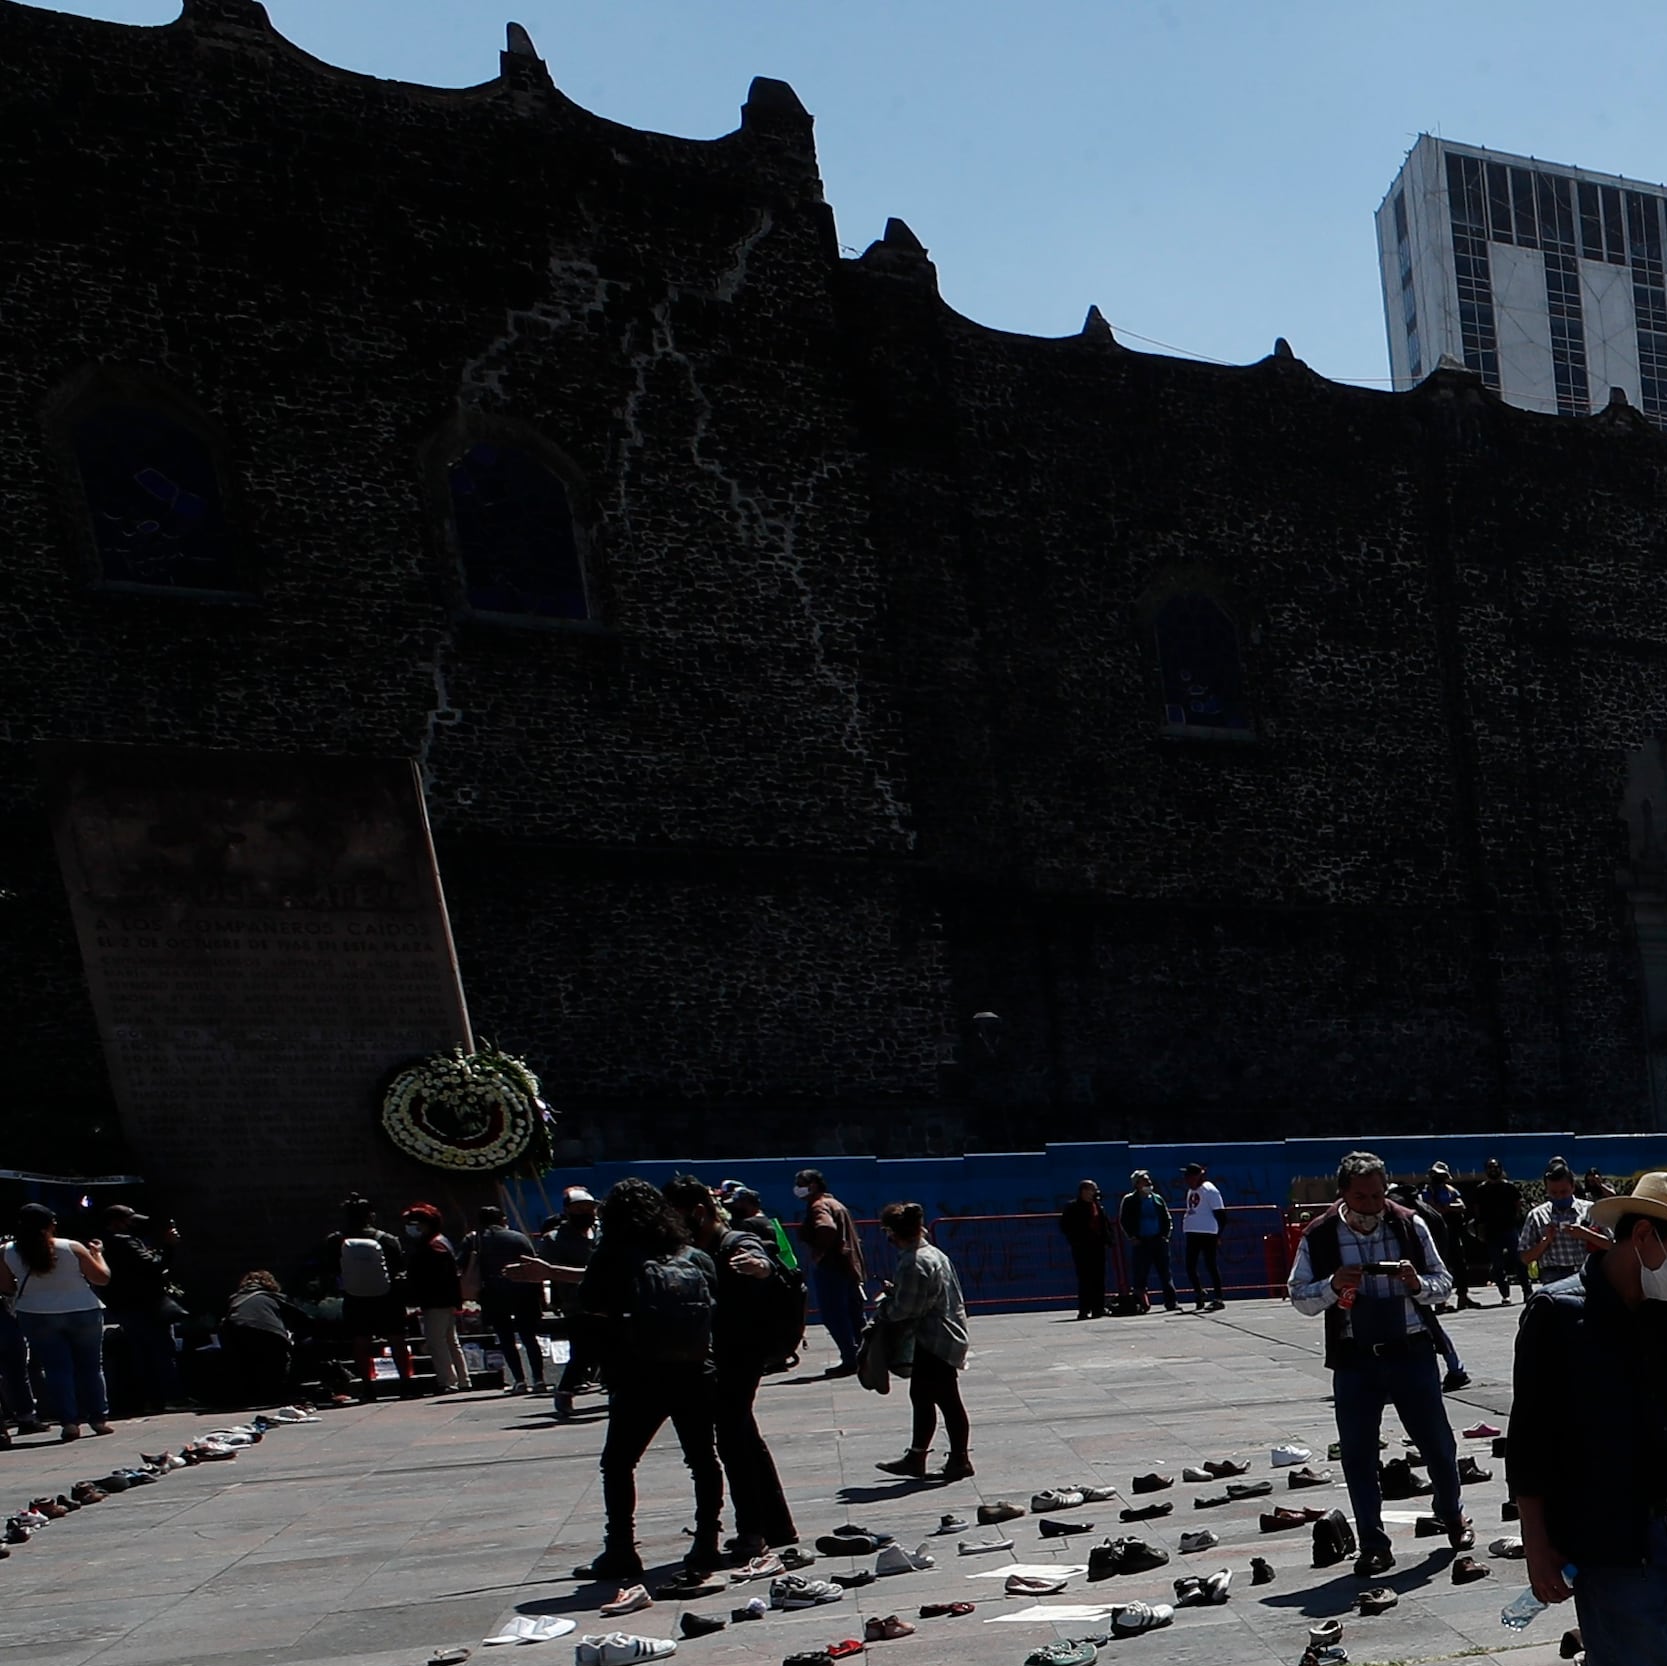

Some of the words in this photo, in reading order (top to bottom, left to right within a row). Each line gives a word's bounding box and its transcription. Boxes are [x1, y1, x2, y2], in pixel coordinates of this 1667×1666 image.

[122, 917, 162, 931] LOS
[138, 938, 158, 949] DE
[166, 938, 240, 949] OCTUBRE
